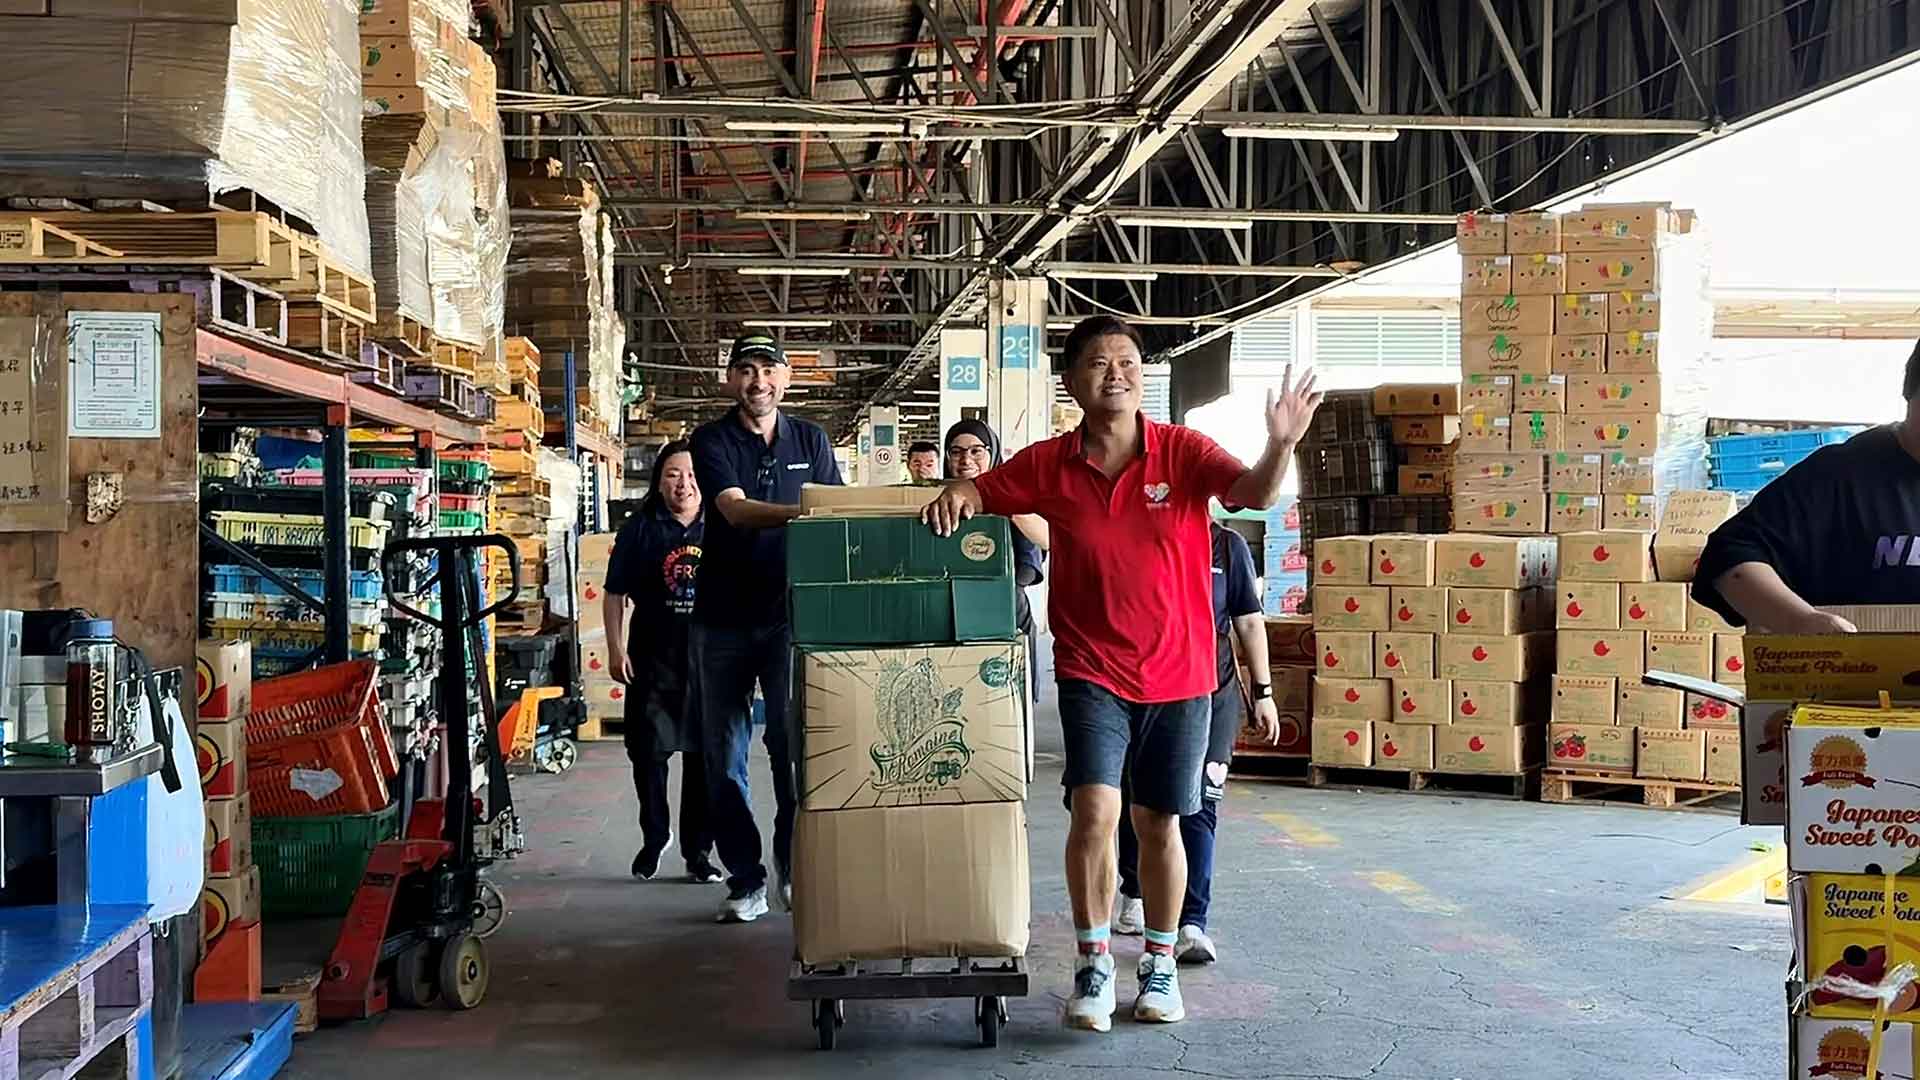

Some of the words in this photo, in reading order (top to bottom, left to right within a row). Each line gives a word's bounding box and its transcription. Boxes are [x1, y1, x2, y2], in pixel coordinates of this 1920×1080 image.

[1002, 336, 1030, 358] 29
[951, 365, 977, 383] 28
[879, 453, 889, 461] 10
[1753, 646, 1843, 664] Japanese
[1755, 661, 1809, 674] Sweet
[1813, 660, 1879, 674] Potato
[91, 668, 105, 733] SHOTAY
[1826, 799, 1920, 829] Japanes
[1805, 824, 1877, 846] Sweet
[1883, 825, 1920, 848] Po
[1824, 902, 1877, 919] Sweet
